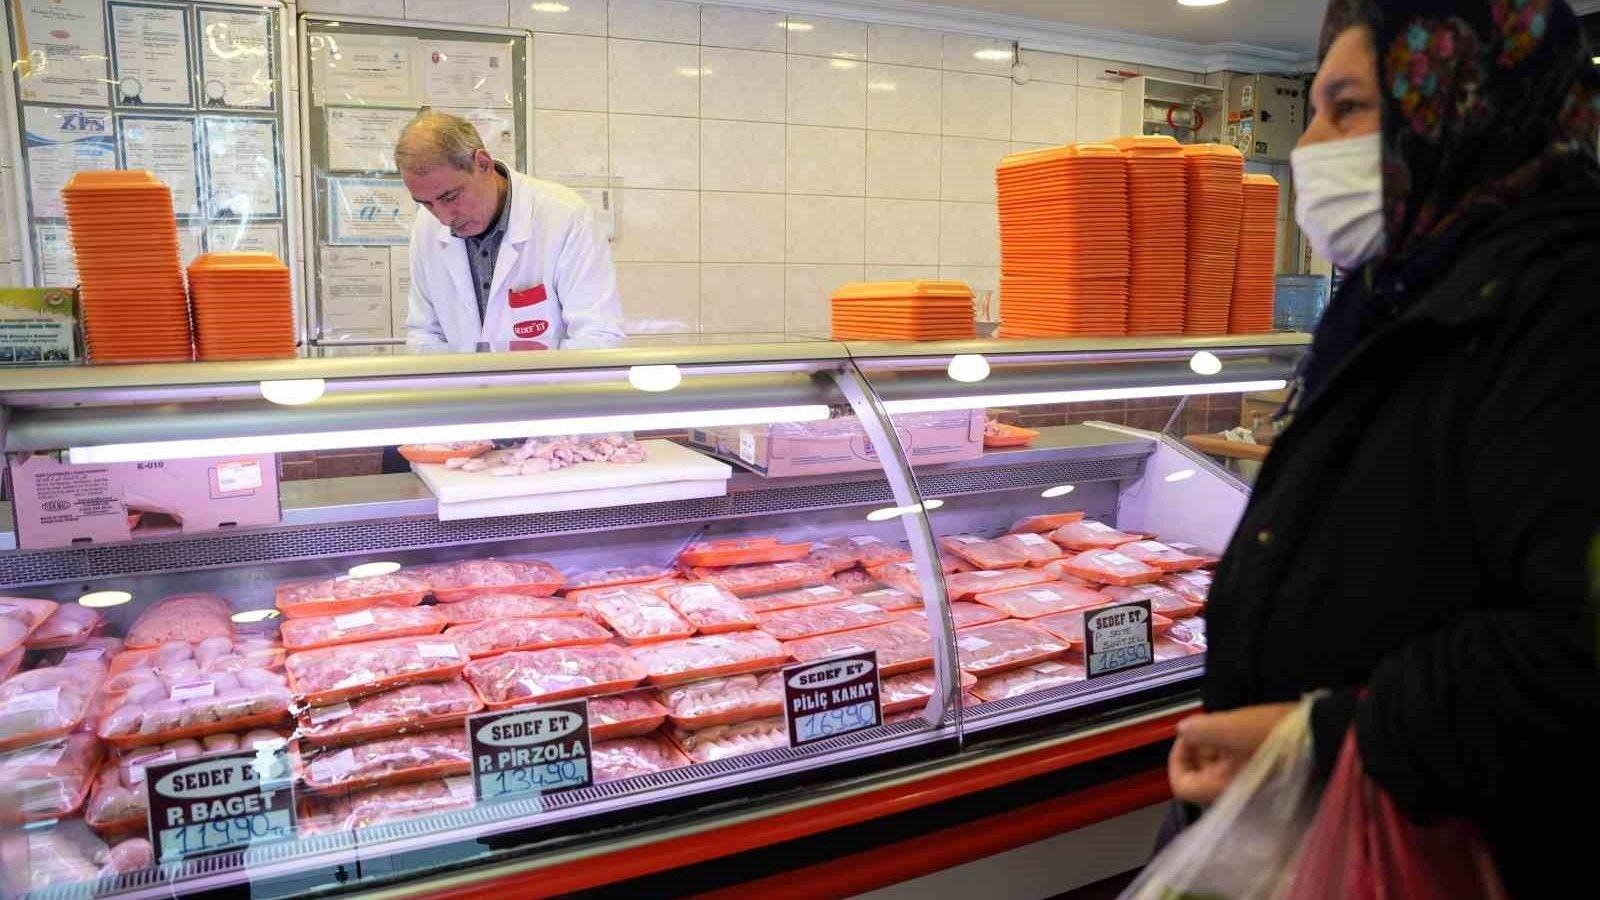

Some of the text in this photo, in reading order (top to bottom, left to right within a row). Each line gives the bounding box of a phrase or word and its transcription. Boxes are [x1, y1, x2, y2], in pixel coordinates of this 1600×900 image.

[1096, 610, 1141, 630] SEDEF ET
[799, 663, 864, 685] SEDEF ET
[793, 682, 874, 713] PİLİÇ KANAT
[491, 715, 569, 741] SEDEF ET
[479, 740, 585, 773] P. PİRZOLA
[172, 764, 260, 792] SEDEF E
[166, 792, 276, 827] P. BAGET
